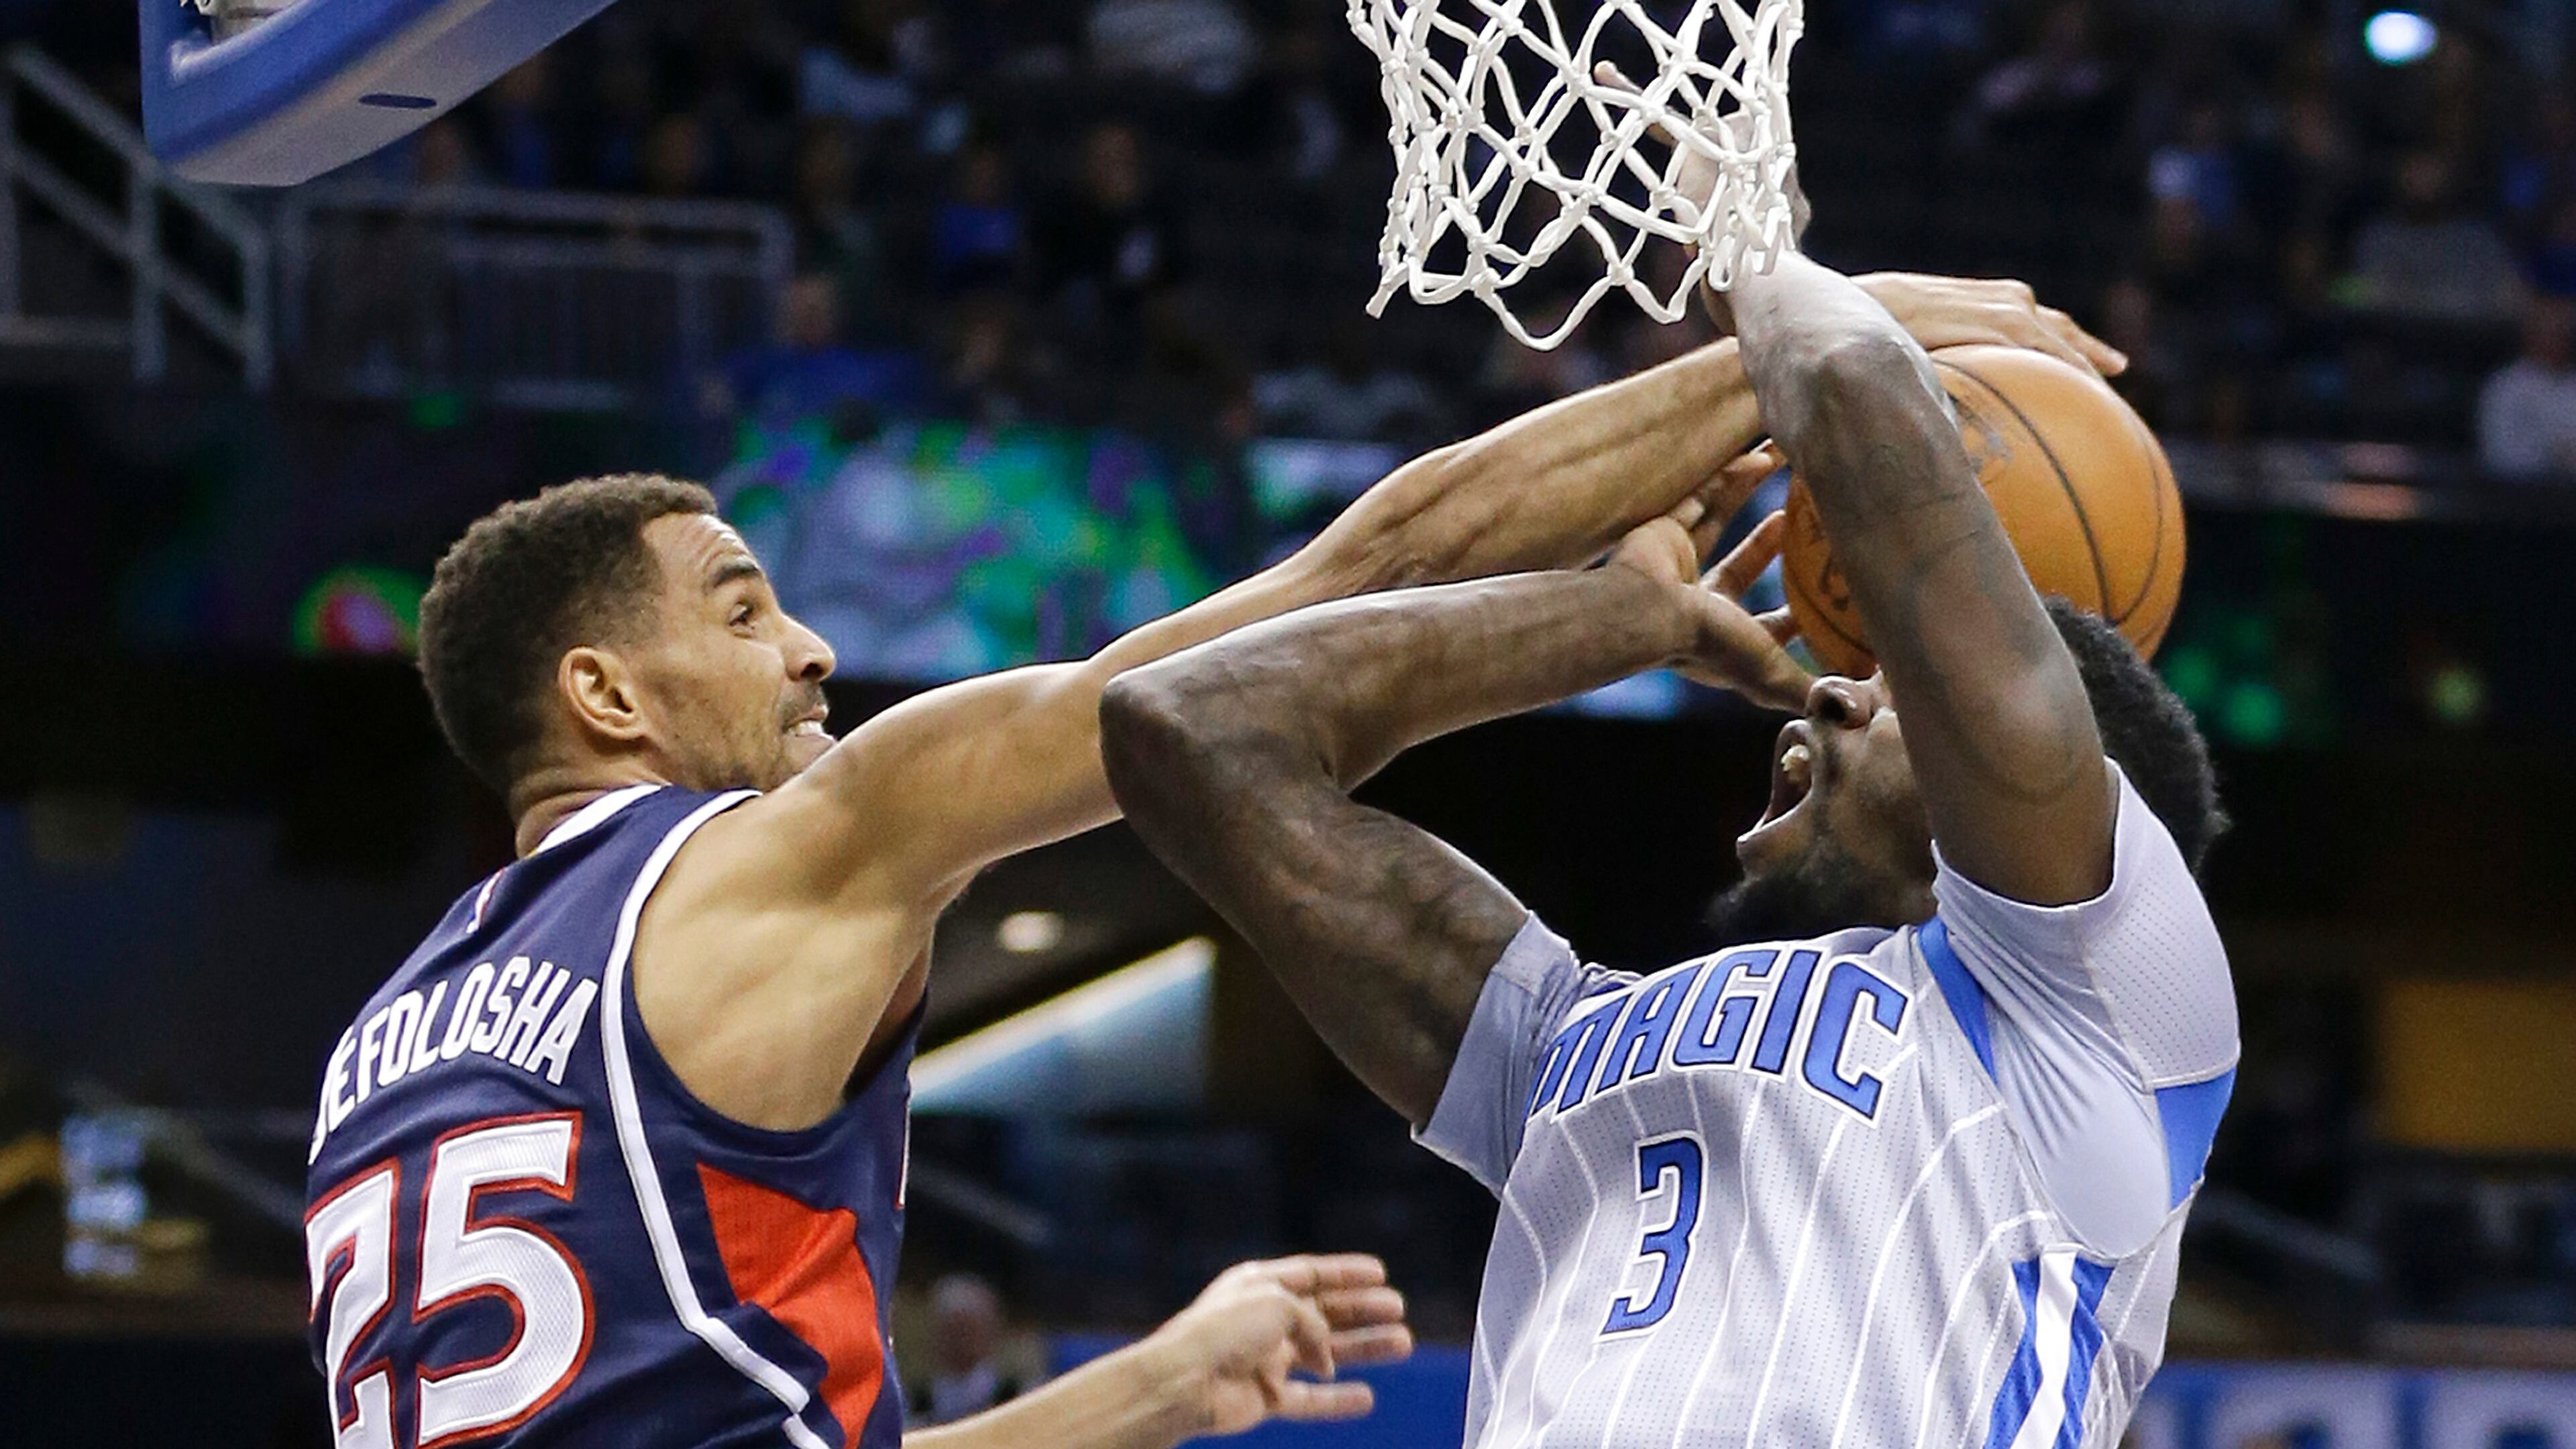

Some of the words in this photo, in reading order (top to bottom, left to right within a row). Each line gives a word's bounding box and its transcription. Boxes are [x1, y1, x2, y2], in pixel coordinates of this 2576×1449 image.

[1525, 945, 1913, 1125] MAGIC
[305, 1111, 595, 1449] 25
[1599, 1134, 1706, 1340] 3
